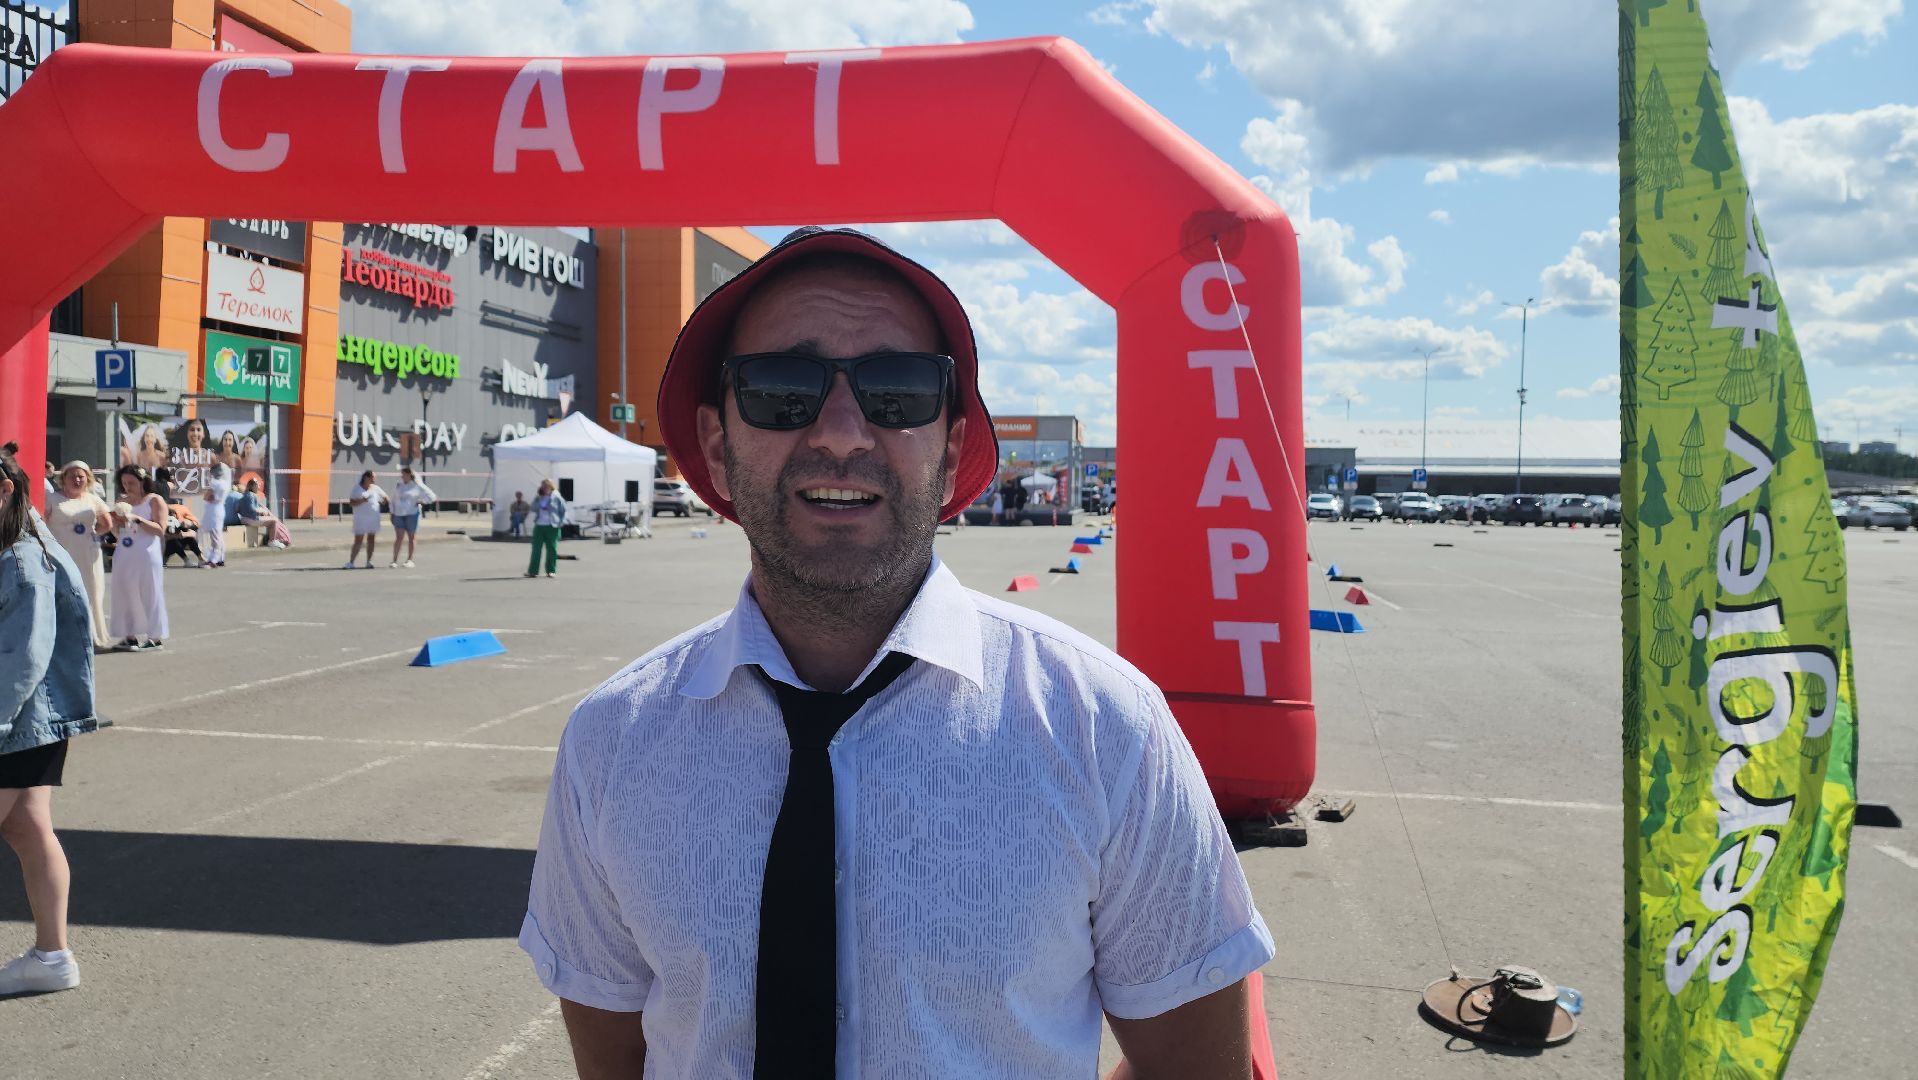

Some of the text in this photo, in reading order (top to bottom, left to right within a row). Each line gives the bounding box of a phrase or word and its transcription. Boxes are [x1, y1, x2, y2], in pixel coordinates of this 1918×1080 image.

[197, 49, 882, 174] СТАРТ
[218, 292, 294, 325] Теремок
[255, 352, 263, 368] 7
[278, 354, 286, 370] 7
[1180, 261, 1280, 697] СТАРТ
[1664, 421, 1839, 996] Sergiev
